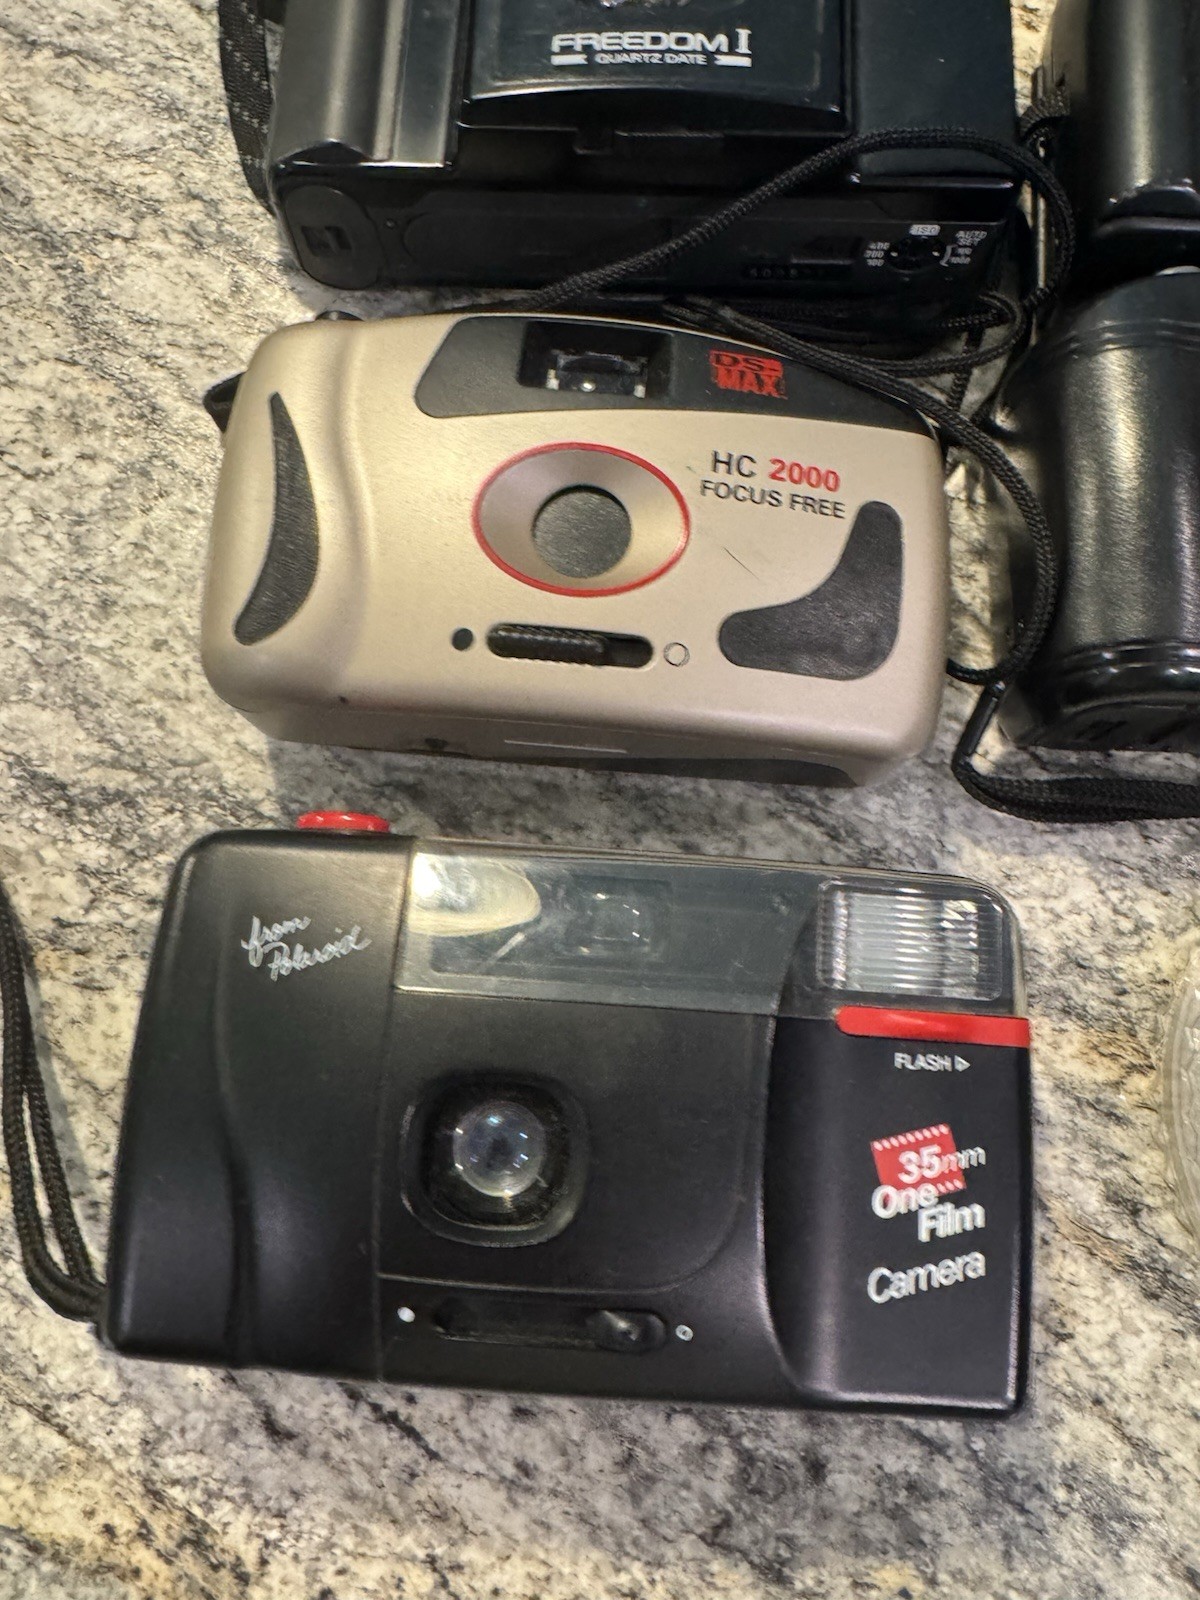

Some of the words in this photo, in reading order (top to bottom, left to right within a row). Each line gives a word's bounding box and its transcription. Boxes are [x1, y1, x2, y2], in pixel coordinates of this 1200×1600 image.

[551, 31, 729, 53] FREEDOM
[594, 52, 662, 65] QUARTZ
[664, 53, 708, 66] DATE
[711, 450, 757, 479] HC
[768, 457, 841, 493] 2000
[700, 479, 784, 508] FOCUS
[789, 493, 846, 519] FREE
[894, 1052, 952, 1072] FLASH
[898, 1144, 986, 1185] 35mm
[871, 1183, 939, 1219] One
[918, 1202, 986, 1243] Film
[867, 1251, 986, 1304] Camera
